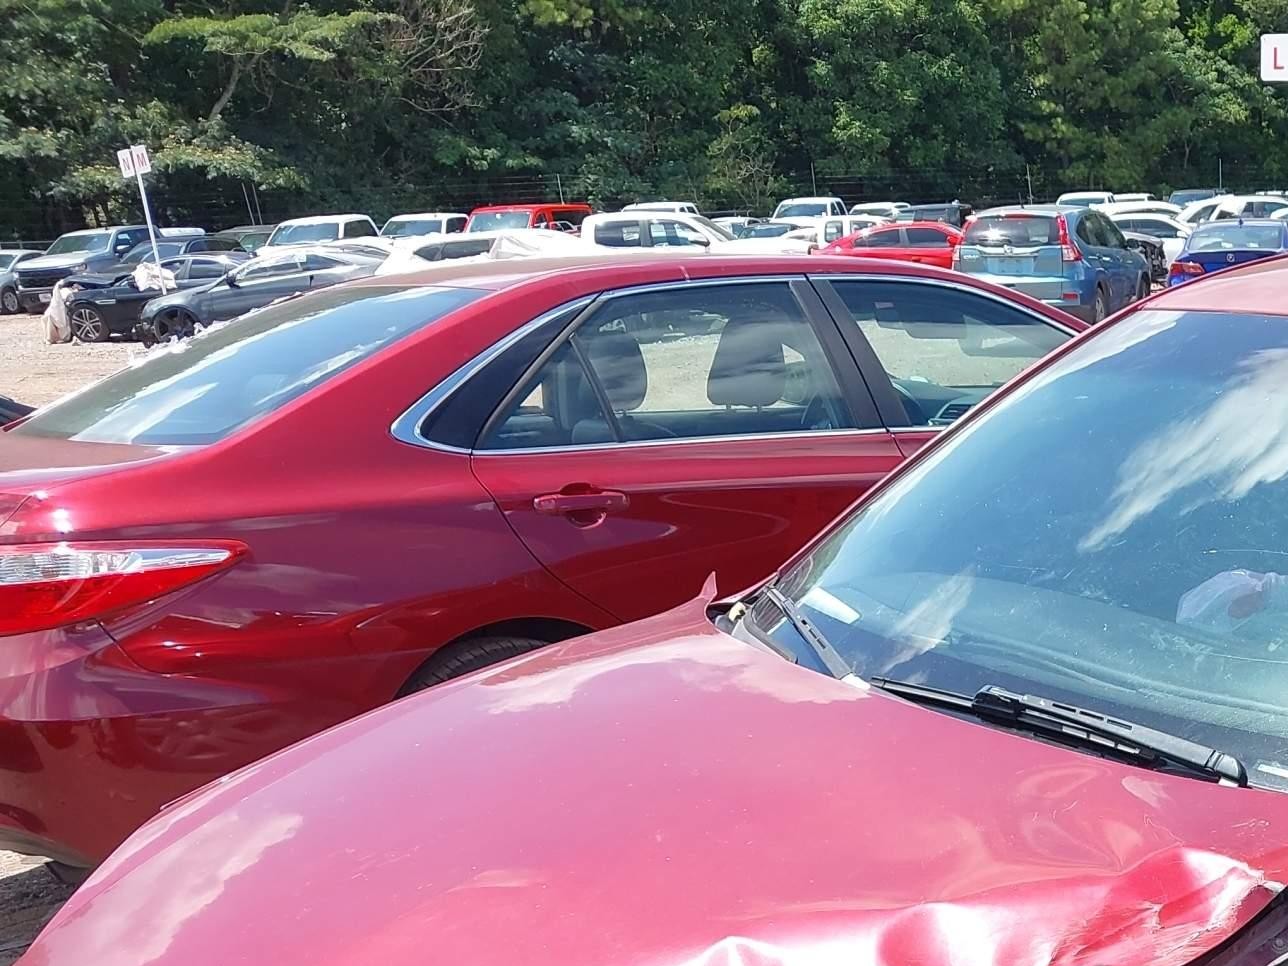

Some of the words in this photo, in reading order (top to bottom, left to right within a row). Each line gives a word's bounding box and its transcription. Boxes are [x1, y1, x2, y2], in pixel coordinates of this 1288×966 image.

[1273, 47, 1285, 70] L
[122, 157, 131, 171] N
[136, 152, 147, 168] M
